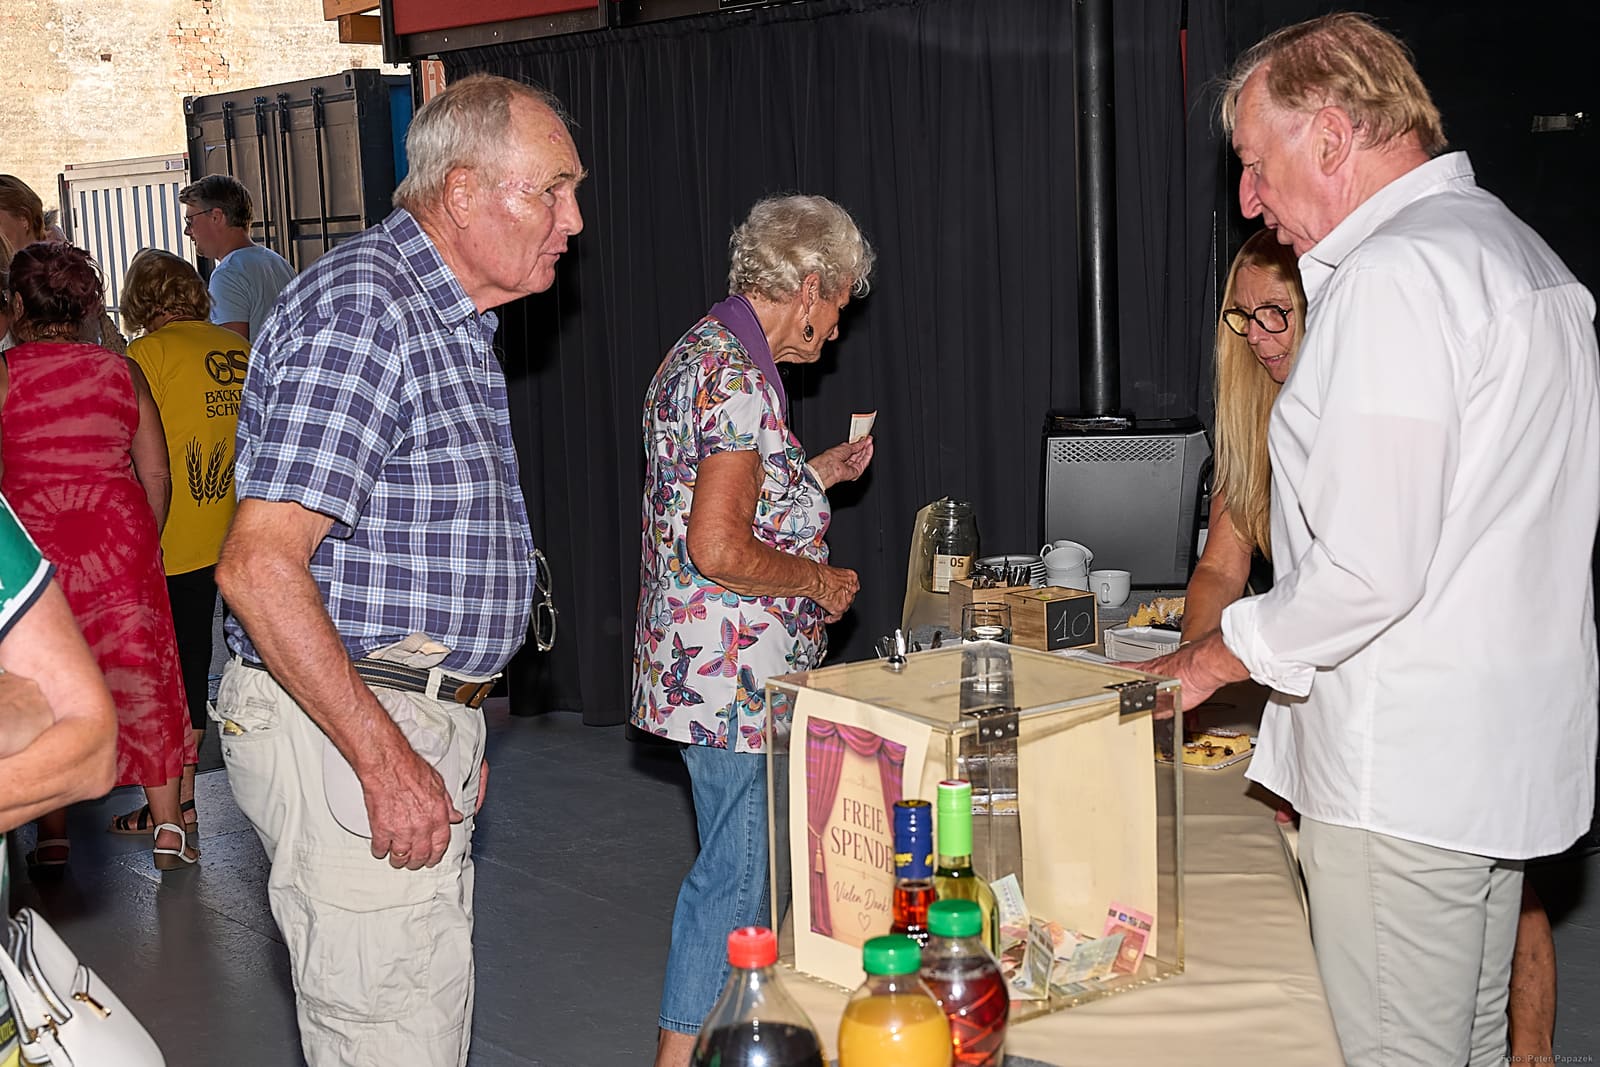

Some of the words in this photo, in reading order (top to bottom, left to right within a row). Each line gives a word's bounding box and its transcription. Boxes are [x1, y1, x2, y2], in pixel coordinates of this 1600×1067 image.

[950, 557, 964, 568] 50
[1053, 609, 1091, 642] 10
[843, 797, 884, 835] FREIE
[831, 825, 893, 874] SPENDE
[833, 880, 862, 903] Vielen
